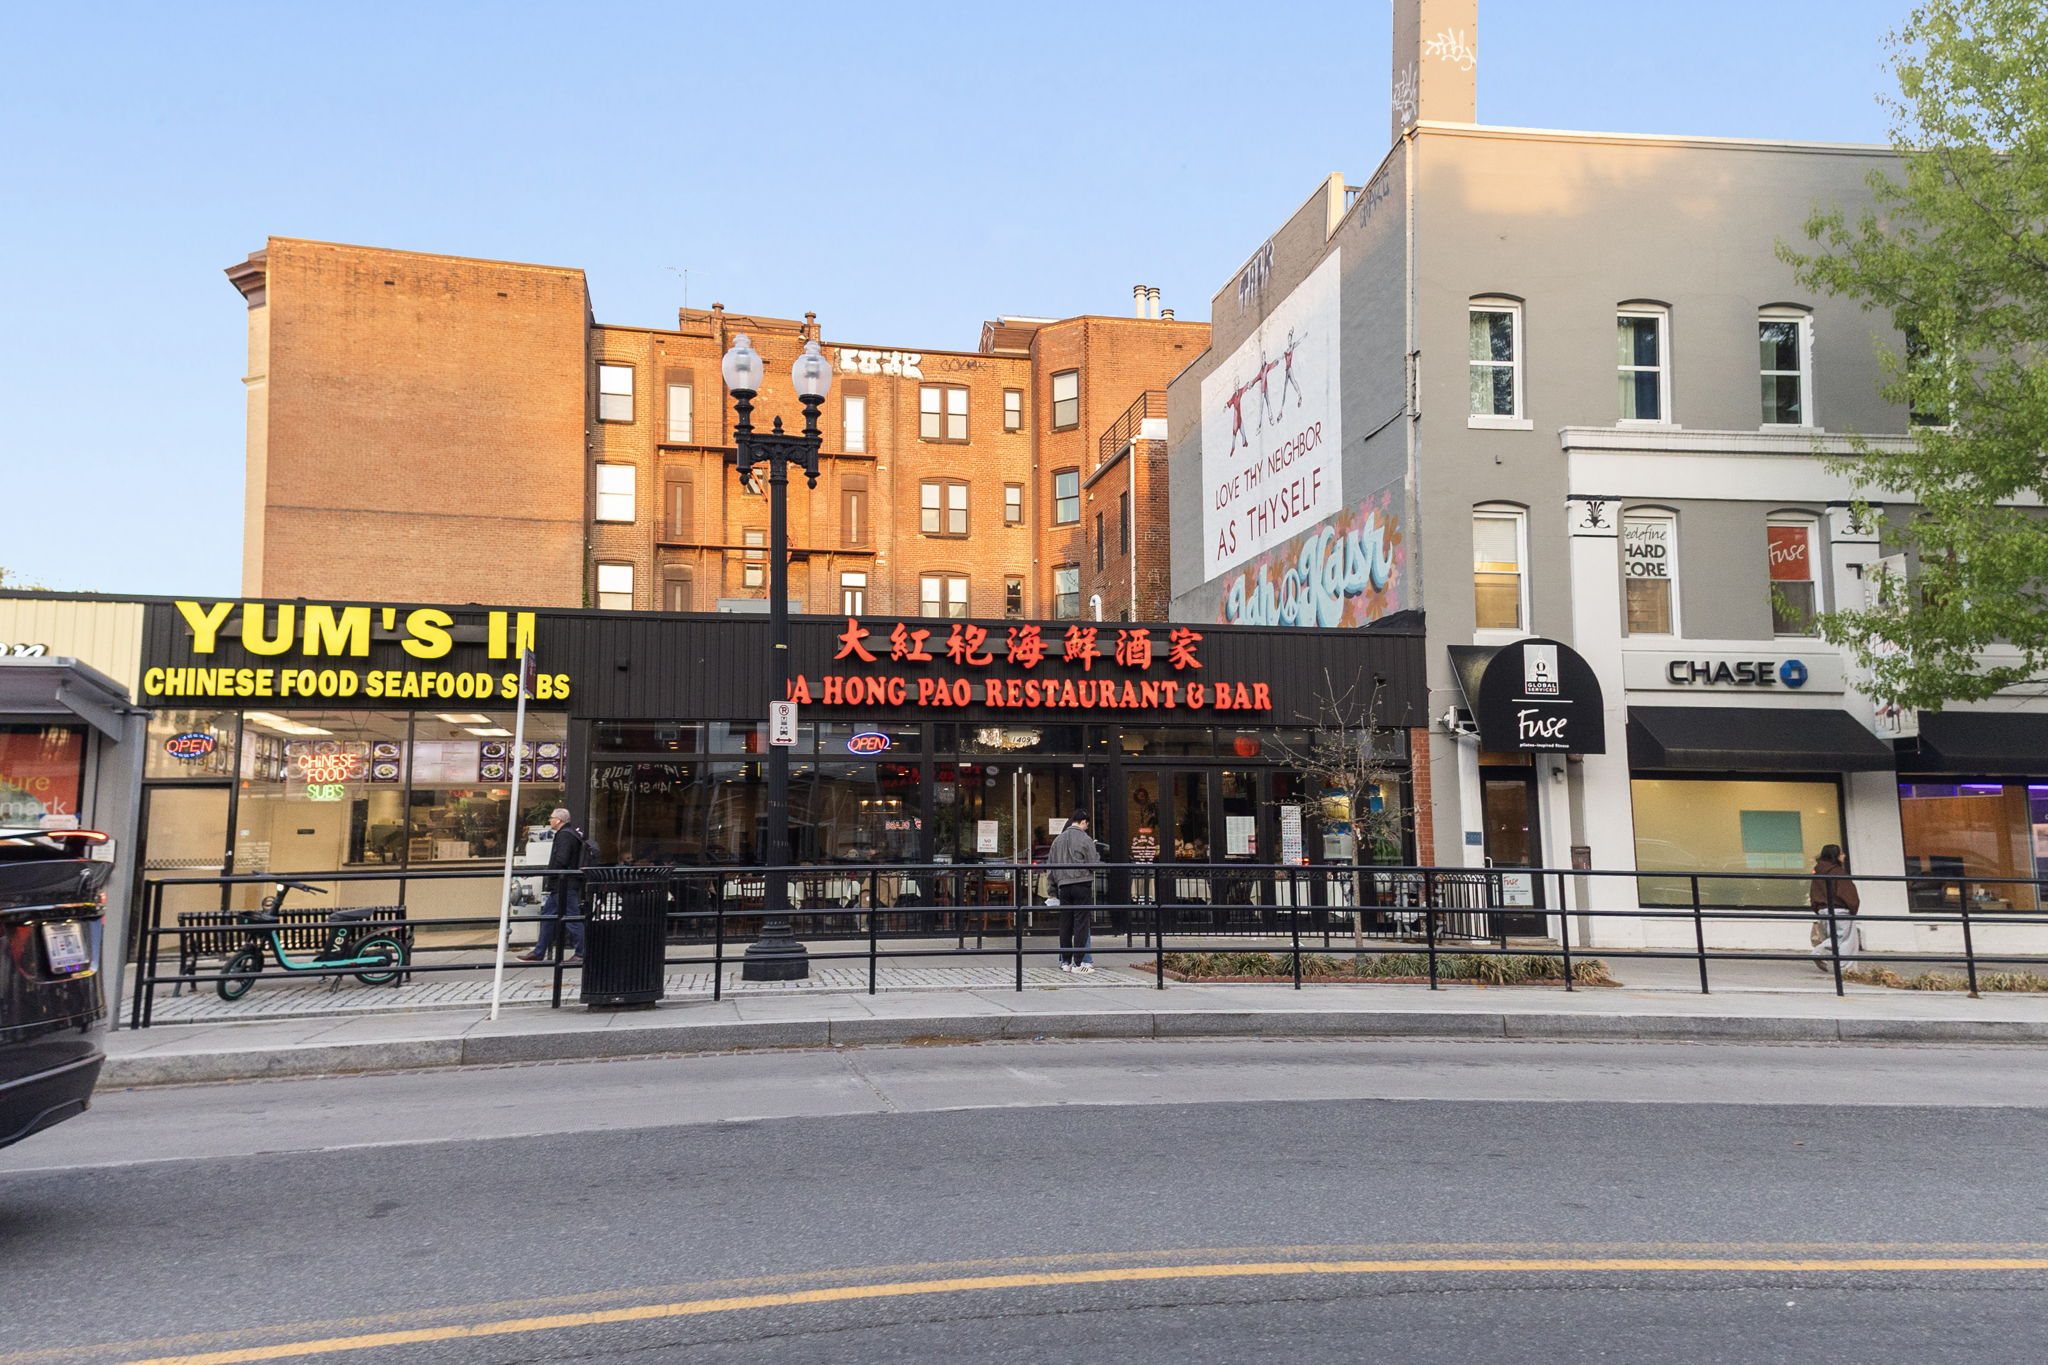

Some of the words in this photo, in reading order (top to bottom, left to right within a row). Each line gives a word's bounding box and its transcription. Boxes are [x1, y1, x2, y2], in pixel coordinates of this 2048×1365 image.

[1215, 475, 1240, 510] LOVE
[1244, 459, 1263, 491] THY
[1268, 421, 1322, 478] NEIGHBOR
[1217, 520, 1237, 560] AS
[1247, 467, 1321, 541] THYSELF
[1768, 541, 1806, 566] Fuse
[175, 600, 454, 659] YUM'S
[488, 611, 536, 659] II
[834, 618, 1203, 671] 大紅袍海鮮酒家
[144, 667, 274, 696] CHINESE
[280, 669, 359, 697] FOOD
[365, 670, 494, 699] SEAFOOD
[501, 673, 571, 700] SBS
[1666, 660, 1777, 685] CHASE
[787, 674, 812, 704] A
[822, 675, 907, 706] HONG
[917, 677, 972, 706] PAO
[985, 678, 1179, 709] RESTAURANT
[1186, 681, 1205, 709] &
[1214, 681, 1272, 710] BAR
[1517, 709, 1568, 740] Fuse
[167, 739, 214, 753] OPEN
[850, 737, 887, 751] OPEN
[306, 767, 347, 783] FOOD
[0, 796, 67, 816] mark
[330, 928, 348, 952] veo
